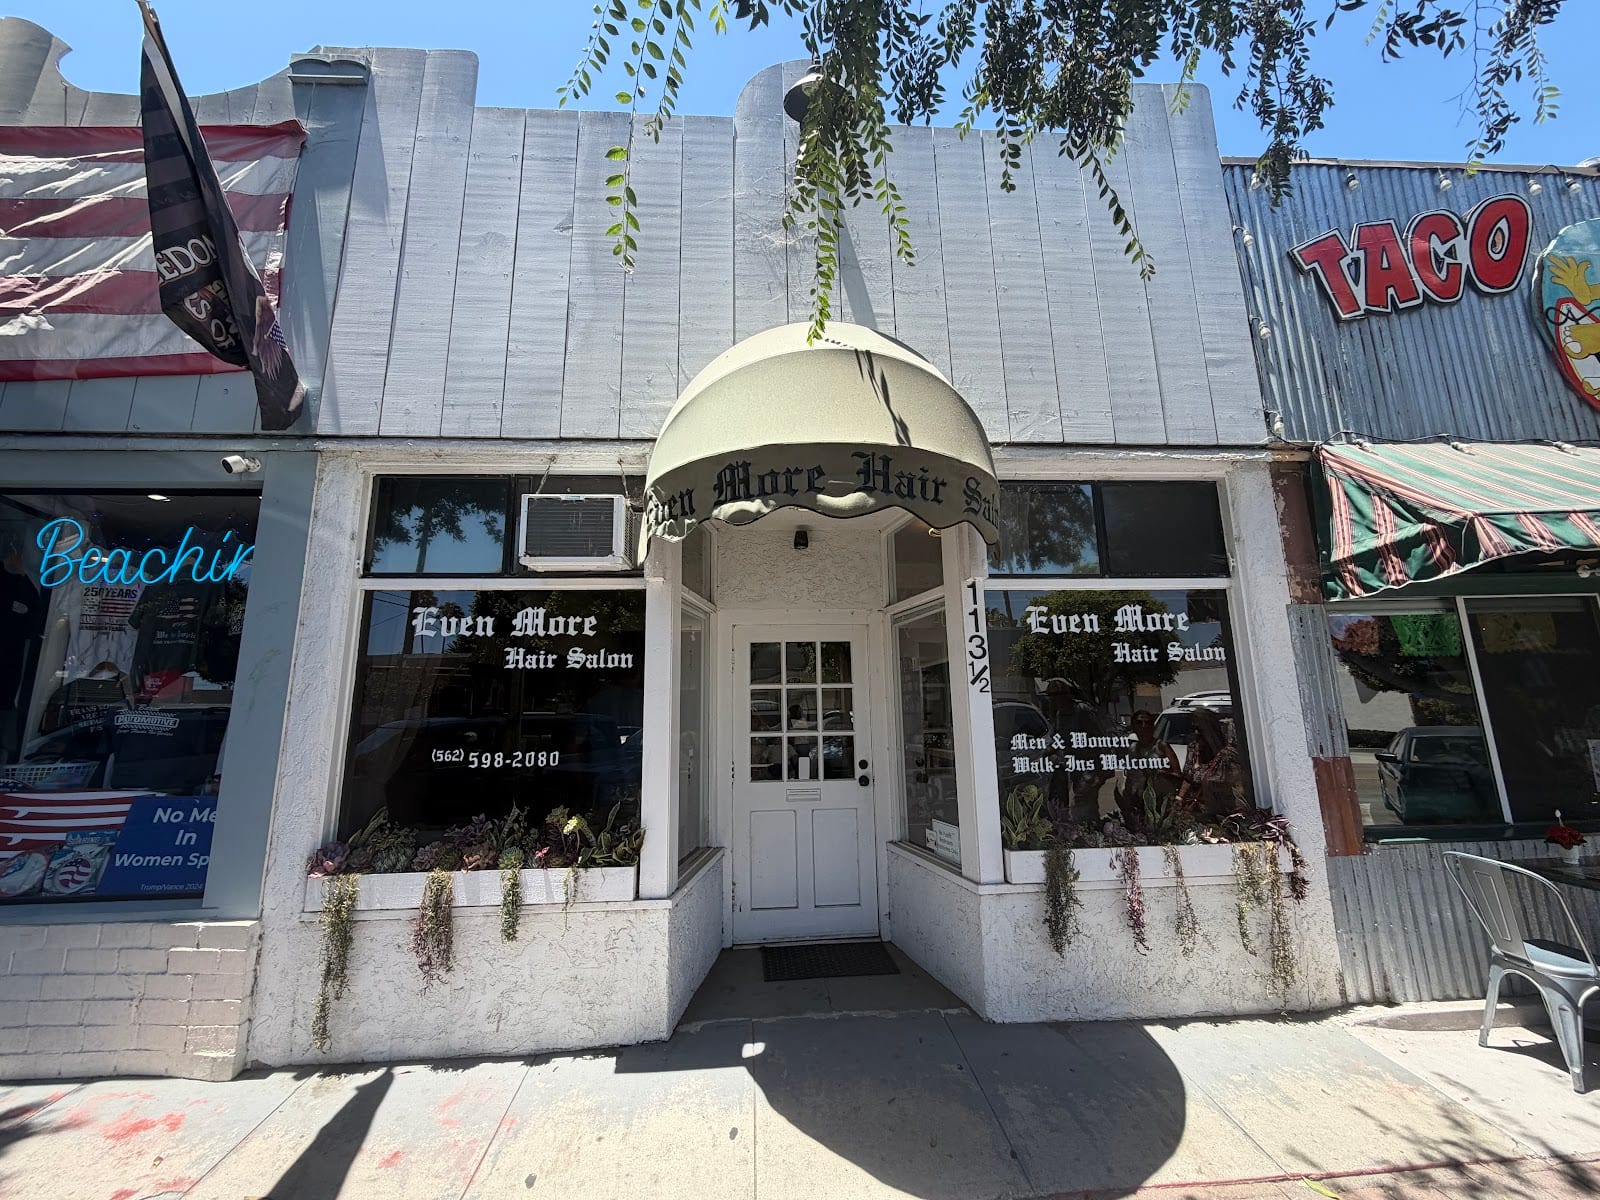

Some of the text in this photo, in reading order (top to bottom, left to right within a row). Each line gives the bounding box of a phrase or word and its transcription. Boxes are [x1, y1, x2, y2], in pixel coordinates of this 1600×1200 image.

[156, 234, 217, 283] EDO
[1289, 192, 1533, 320] TACO
[712, 460, 826, 506] More
[850, 451, 947, 504] Hair
[105, 587, 138, 599] YEARS
[411, 606, 598, 637] Even More
[1025, 604, 1190, 634] Even More
[503, 646, 634, 669] Hair Salon
[1111, 641, 1227, 663] Hair Salon
[1010, 731, 1132, 751] Men & Women
[431, 749, 560, 768] (562) 598-2080
[1100, 754, 1171, 772] Welcome
[152, 807, 184, 823] No
[175, 830, 197, 846] In
[114, 853, 183, 868] Women
